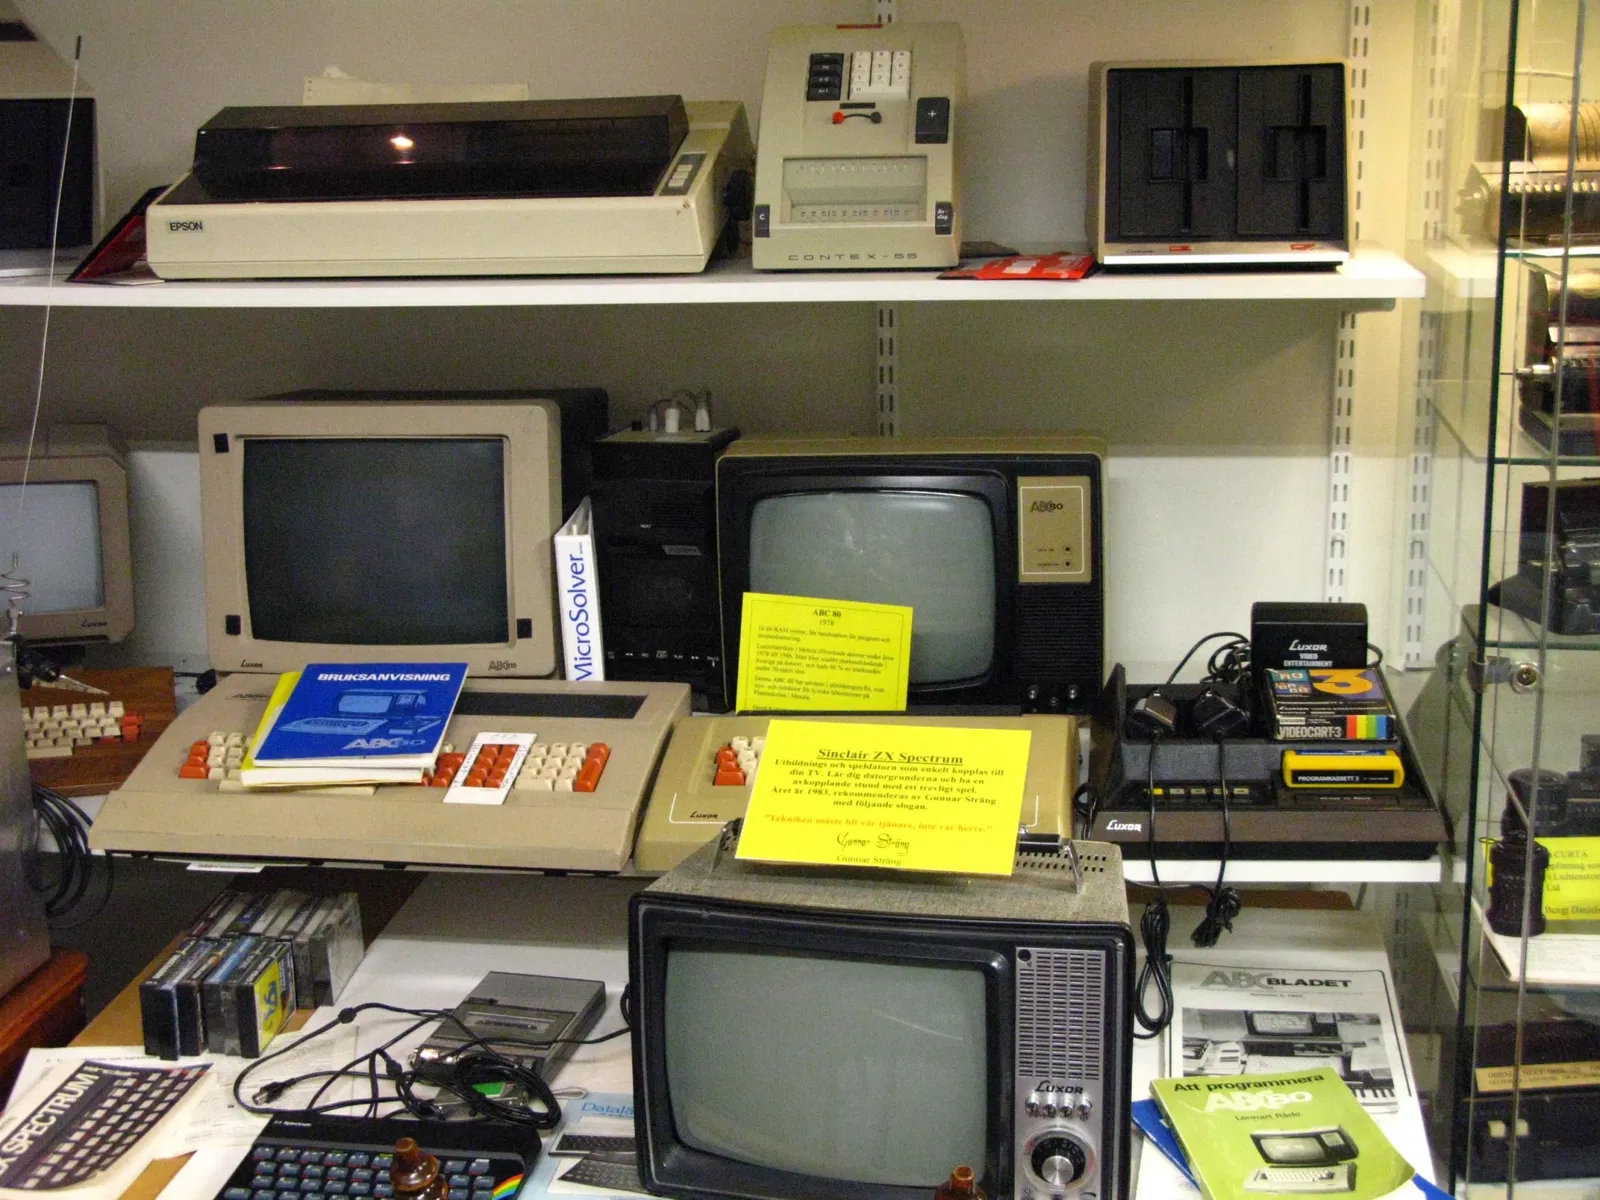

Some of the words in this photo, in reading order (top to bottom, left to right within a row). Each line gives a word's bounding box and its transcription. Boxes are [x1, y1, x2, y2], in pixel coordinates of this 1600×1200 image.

[169, 221, 203, 232] EPSON
[812, 609, 830, 617] ABC
[317, 673, 451, 682] BRUKSANVISNING
[1308, 668, 1374, 694] 3
[818, 748, 869, 760] Sinclair
[873, 751, 894, 761] ZX
[899, 752, 963, 764] Spectrum
[775, 759, 828, 768] Utbildnings
[848, 762, 896, 772] speldatorn
[952, 767, 988, 776] kopplas
[846, 772, 861, 780] dig
[864, 772, 938, 782] datorgrunderna
[792, 779, 852, 788] avkopplande
[771, 786, 791, 794] Året
[834, 790, 908, 800] rekommenderas
[924, 794, 962, 802] Gunnar
[964, 796, 996, 806] Sträng
[856, 800, 894, 808] följande
[896, 802, 928, 810] slogan.
[845, 818, 858, 826] bli
[918, 822, 936, 830] inte
[836, 854, 870, 864] Gunnar
[873, 855, 902, 866] Sträng
[1266, 978, 1352, 988] BLADET
[1174, 1082, 1201, 1092] Att
[1206, 1073, 1324, 1092] programmera
[2, 1072, 100, 1154] SPECTRUM
[1234, 1113, 1273, 1122] Lennart
